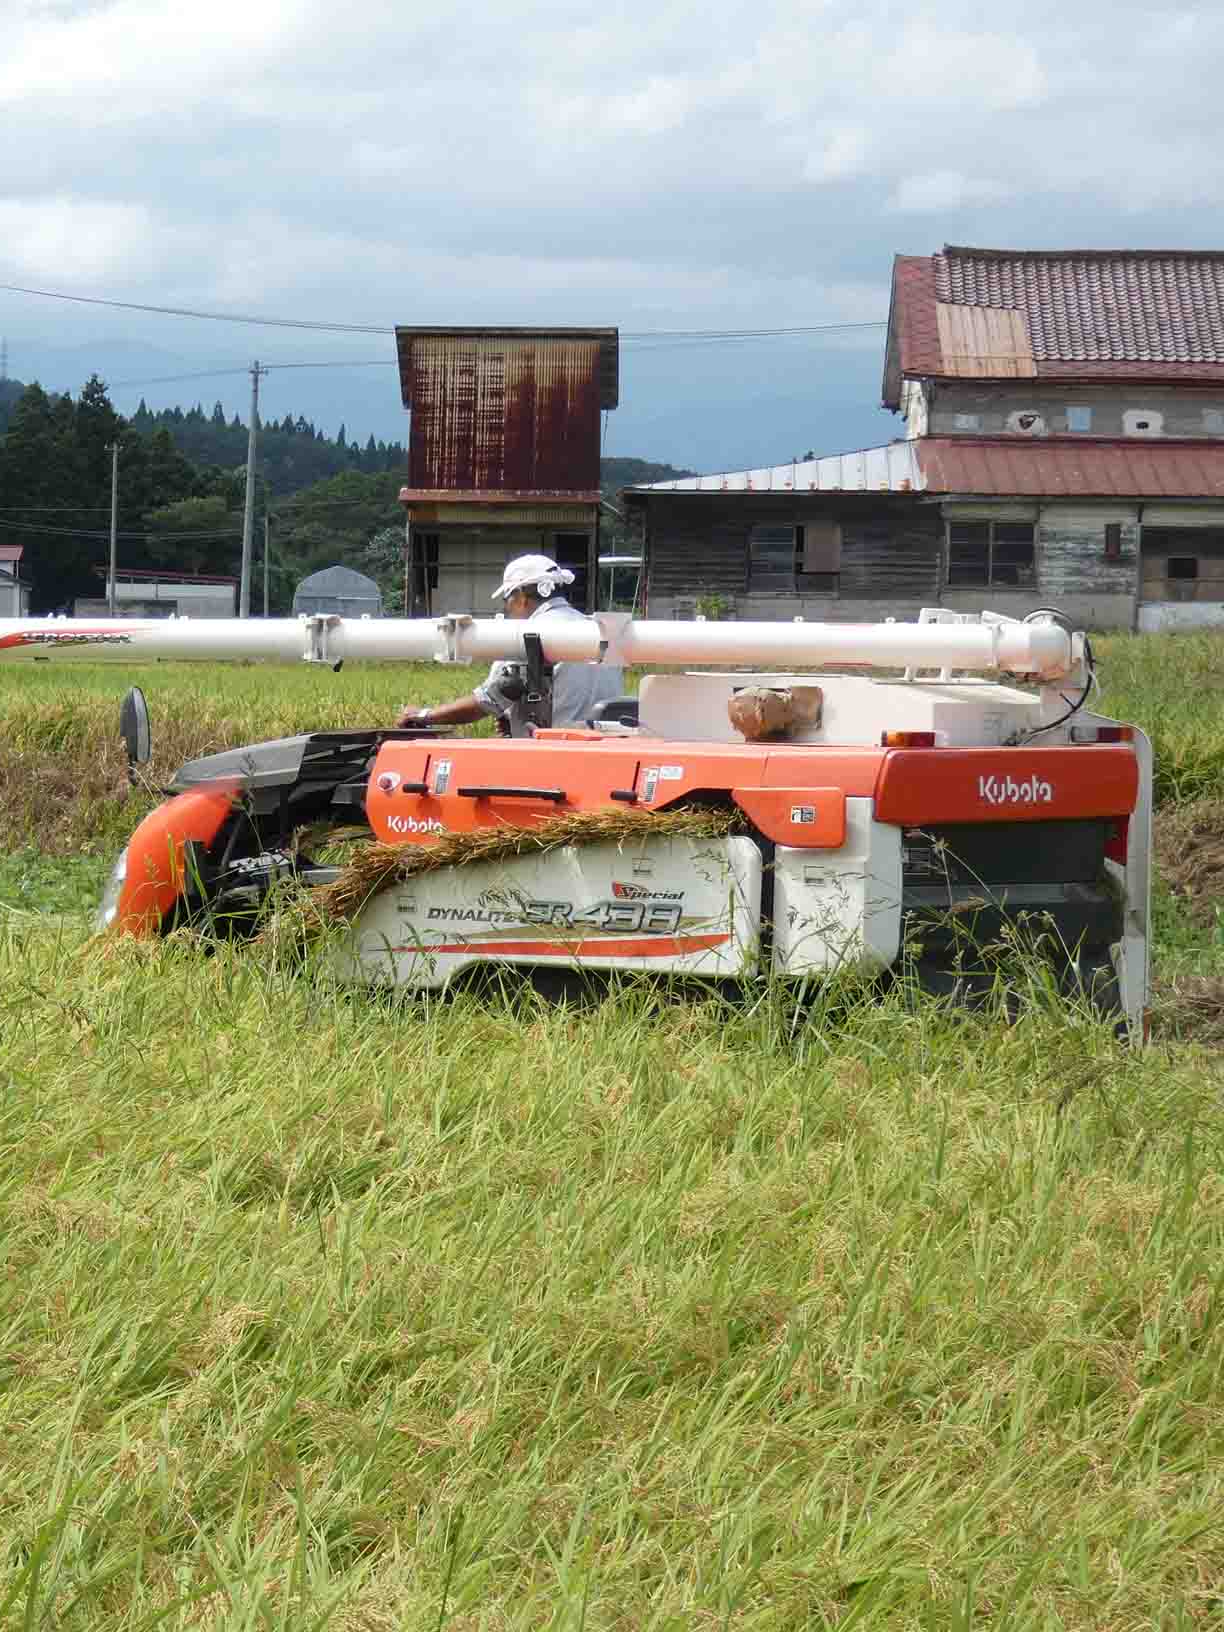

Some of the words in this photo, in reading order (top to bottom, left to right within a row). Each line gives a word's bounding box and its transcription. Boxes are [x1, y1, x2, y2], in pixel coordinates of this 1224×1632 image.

[979, 775, 1052, 803] Kubota
[387, 815, 443, 833] Kubota
[619, 885, 685, 900] Special
